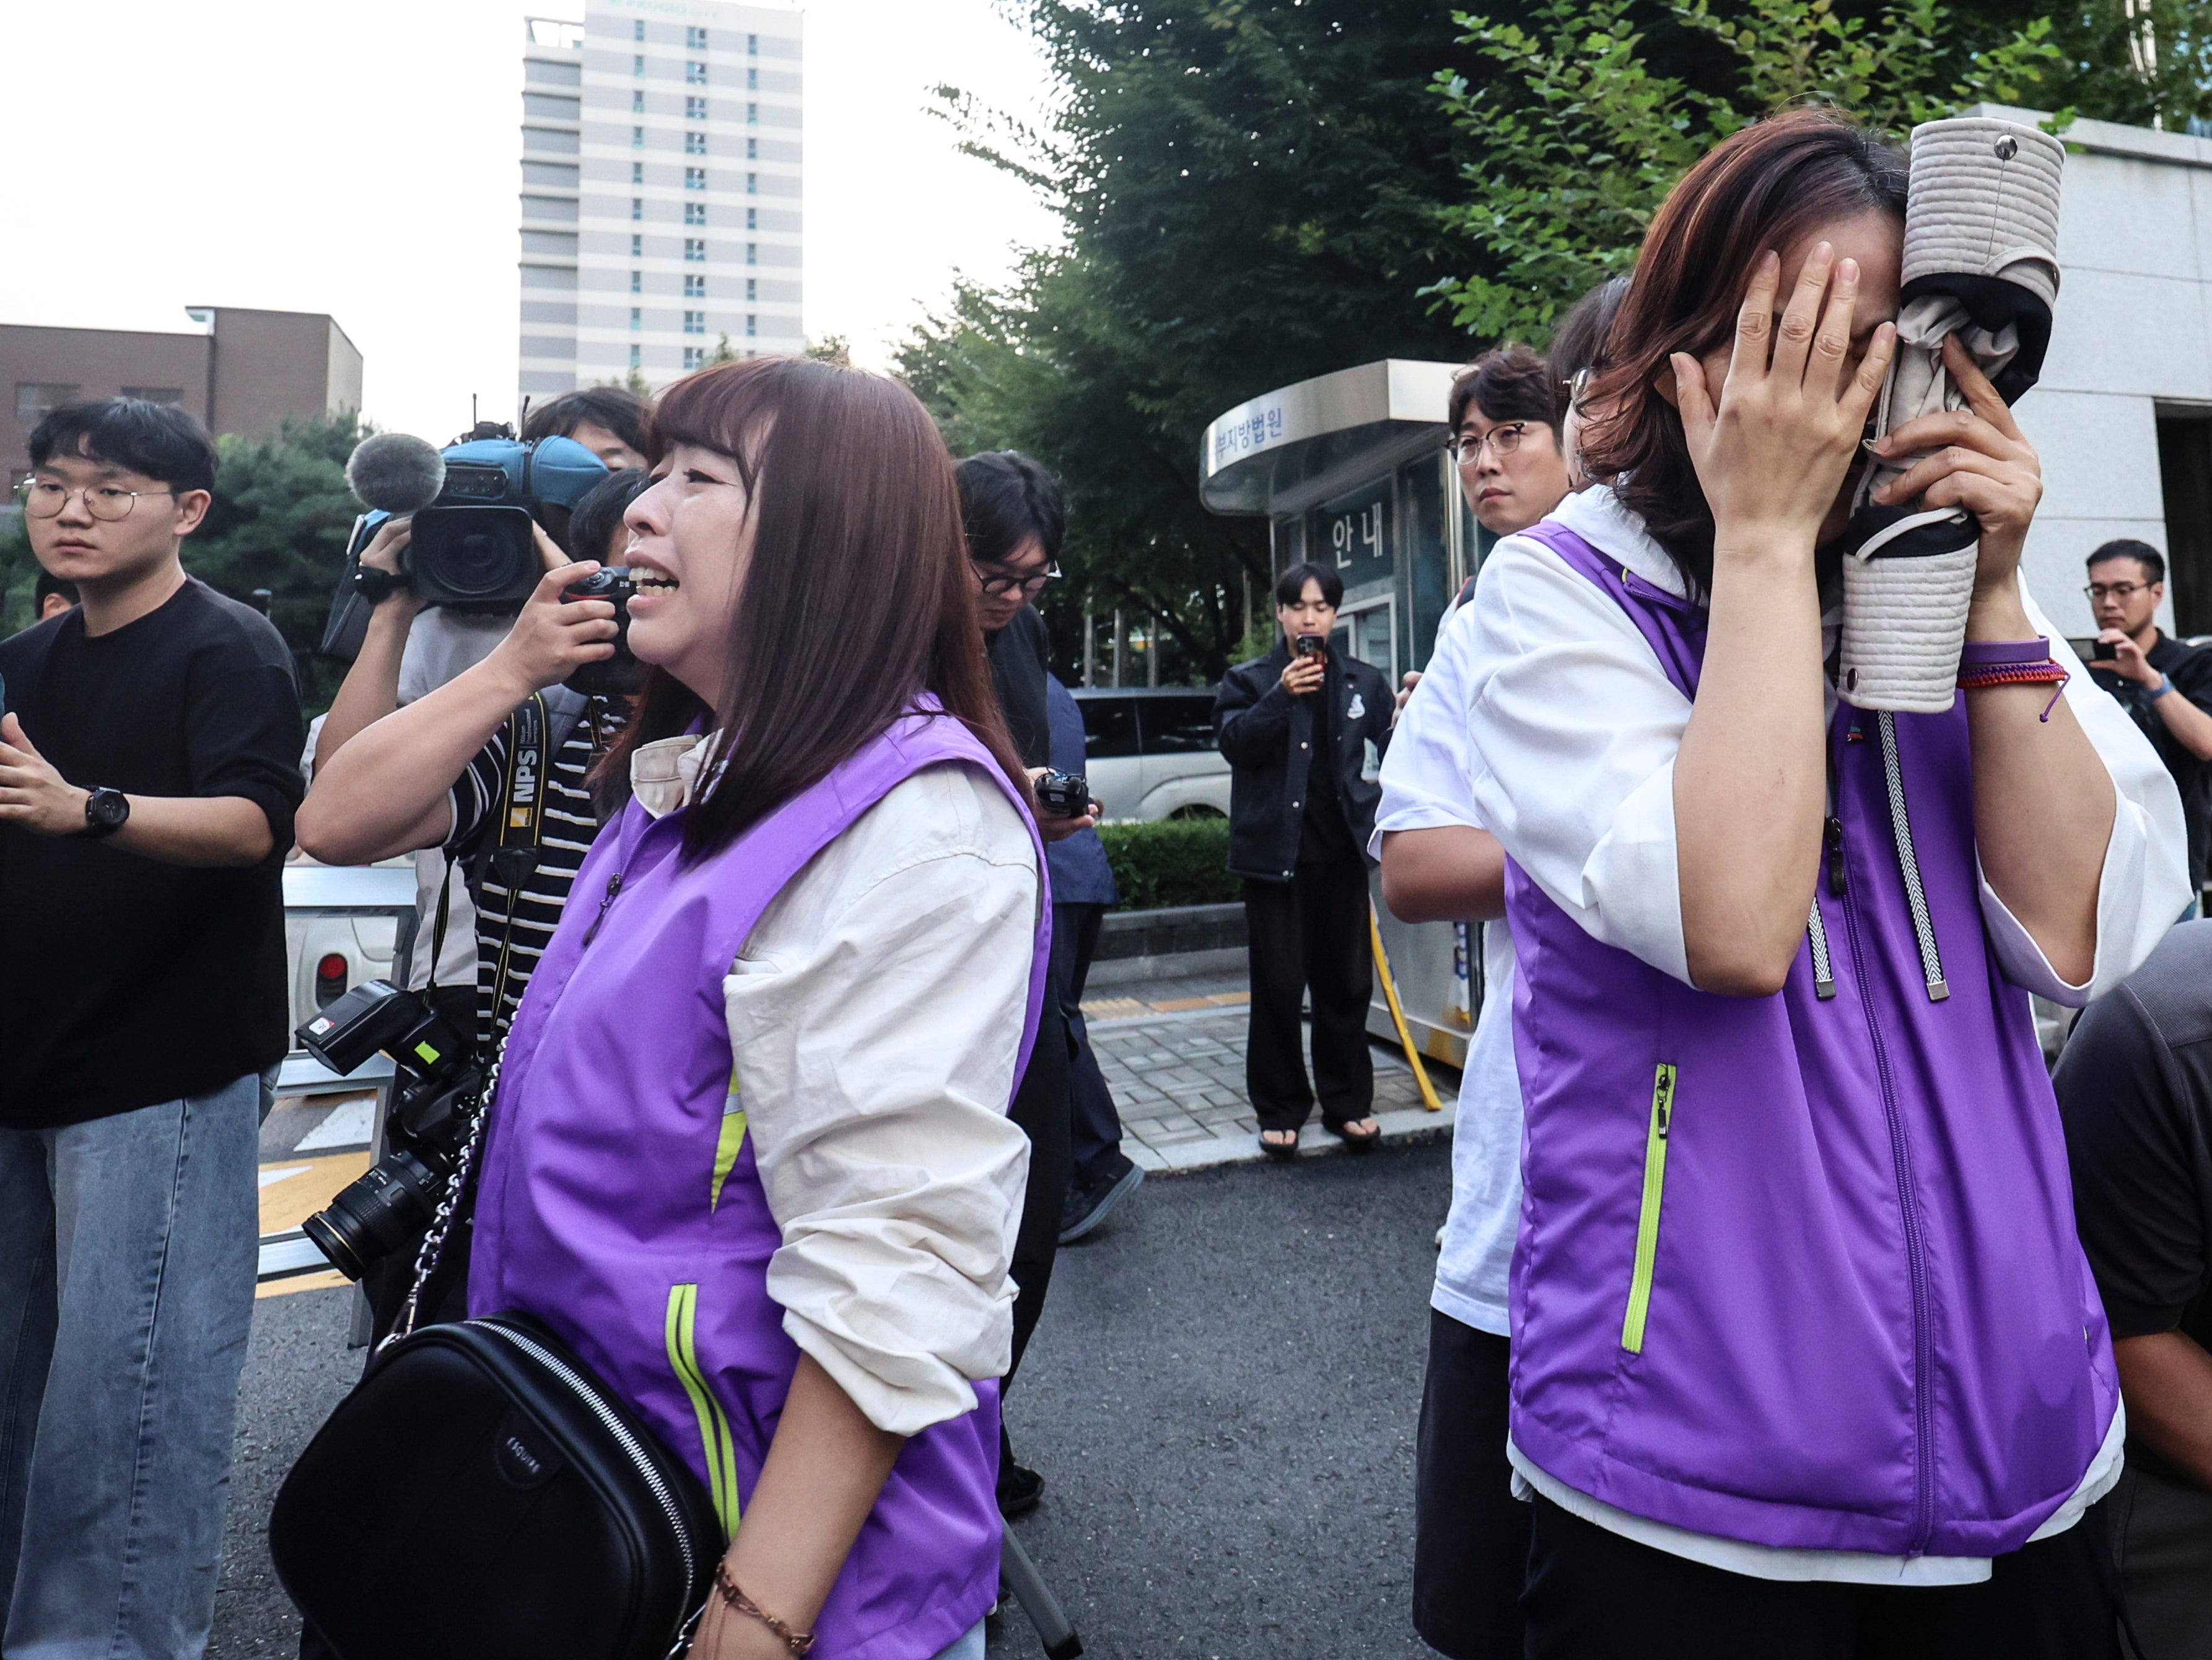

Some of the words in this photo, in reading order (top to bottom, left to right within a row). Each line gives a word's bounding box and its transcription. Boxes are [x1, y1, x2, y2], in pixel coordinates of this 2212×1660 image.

[1216, 408, 1282, 459] 부지방법원
[1333, 502, 1383, 569] 안내
[513, 749, 538, 802] NPS
